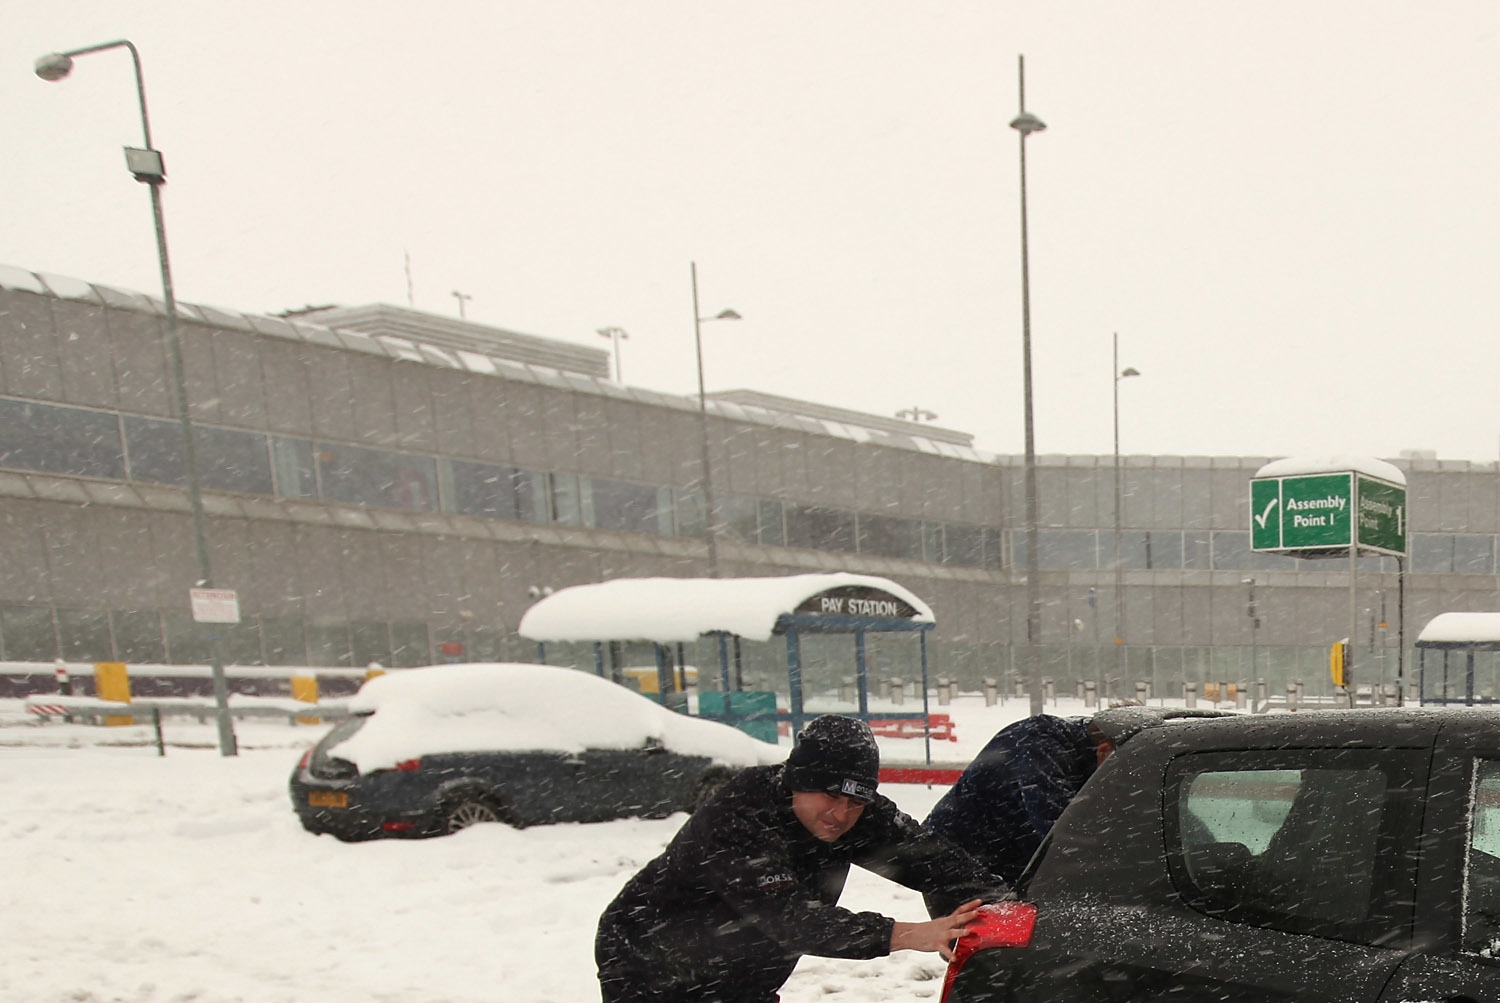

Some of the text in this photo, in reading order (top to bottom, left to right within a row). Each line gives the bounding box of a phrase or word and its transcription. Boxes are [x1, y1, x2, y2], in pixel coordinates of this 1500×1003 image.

[1286, 495, 1346, 512] Assembly
[1294, 513, 1326, 528] Point
[821, 598, 897, 616] PAY STATION
